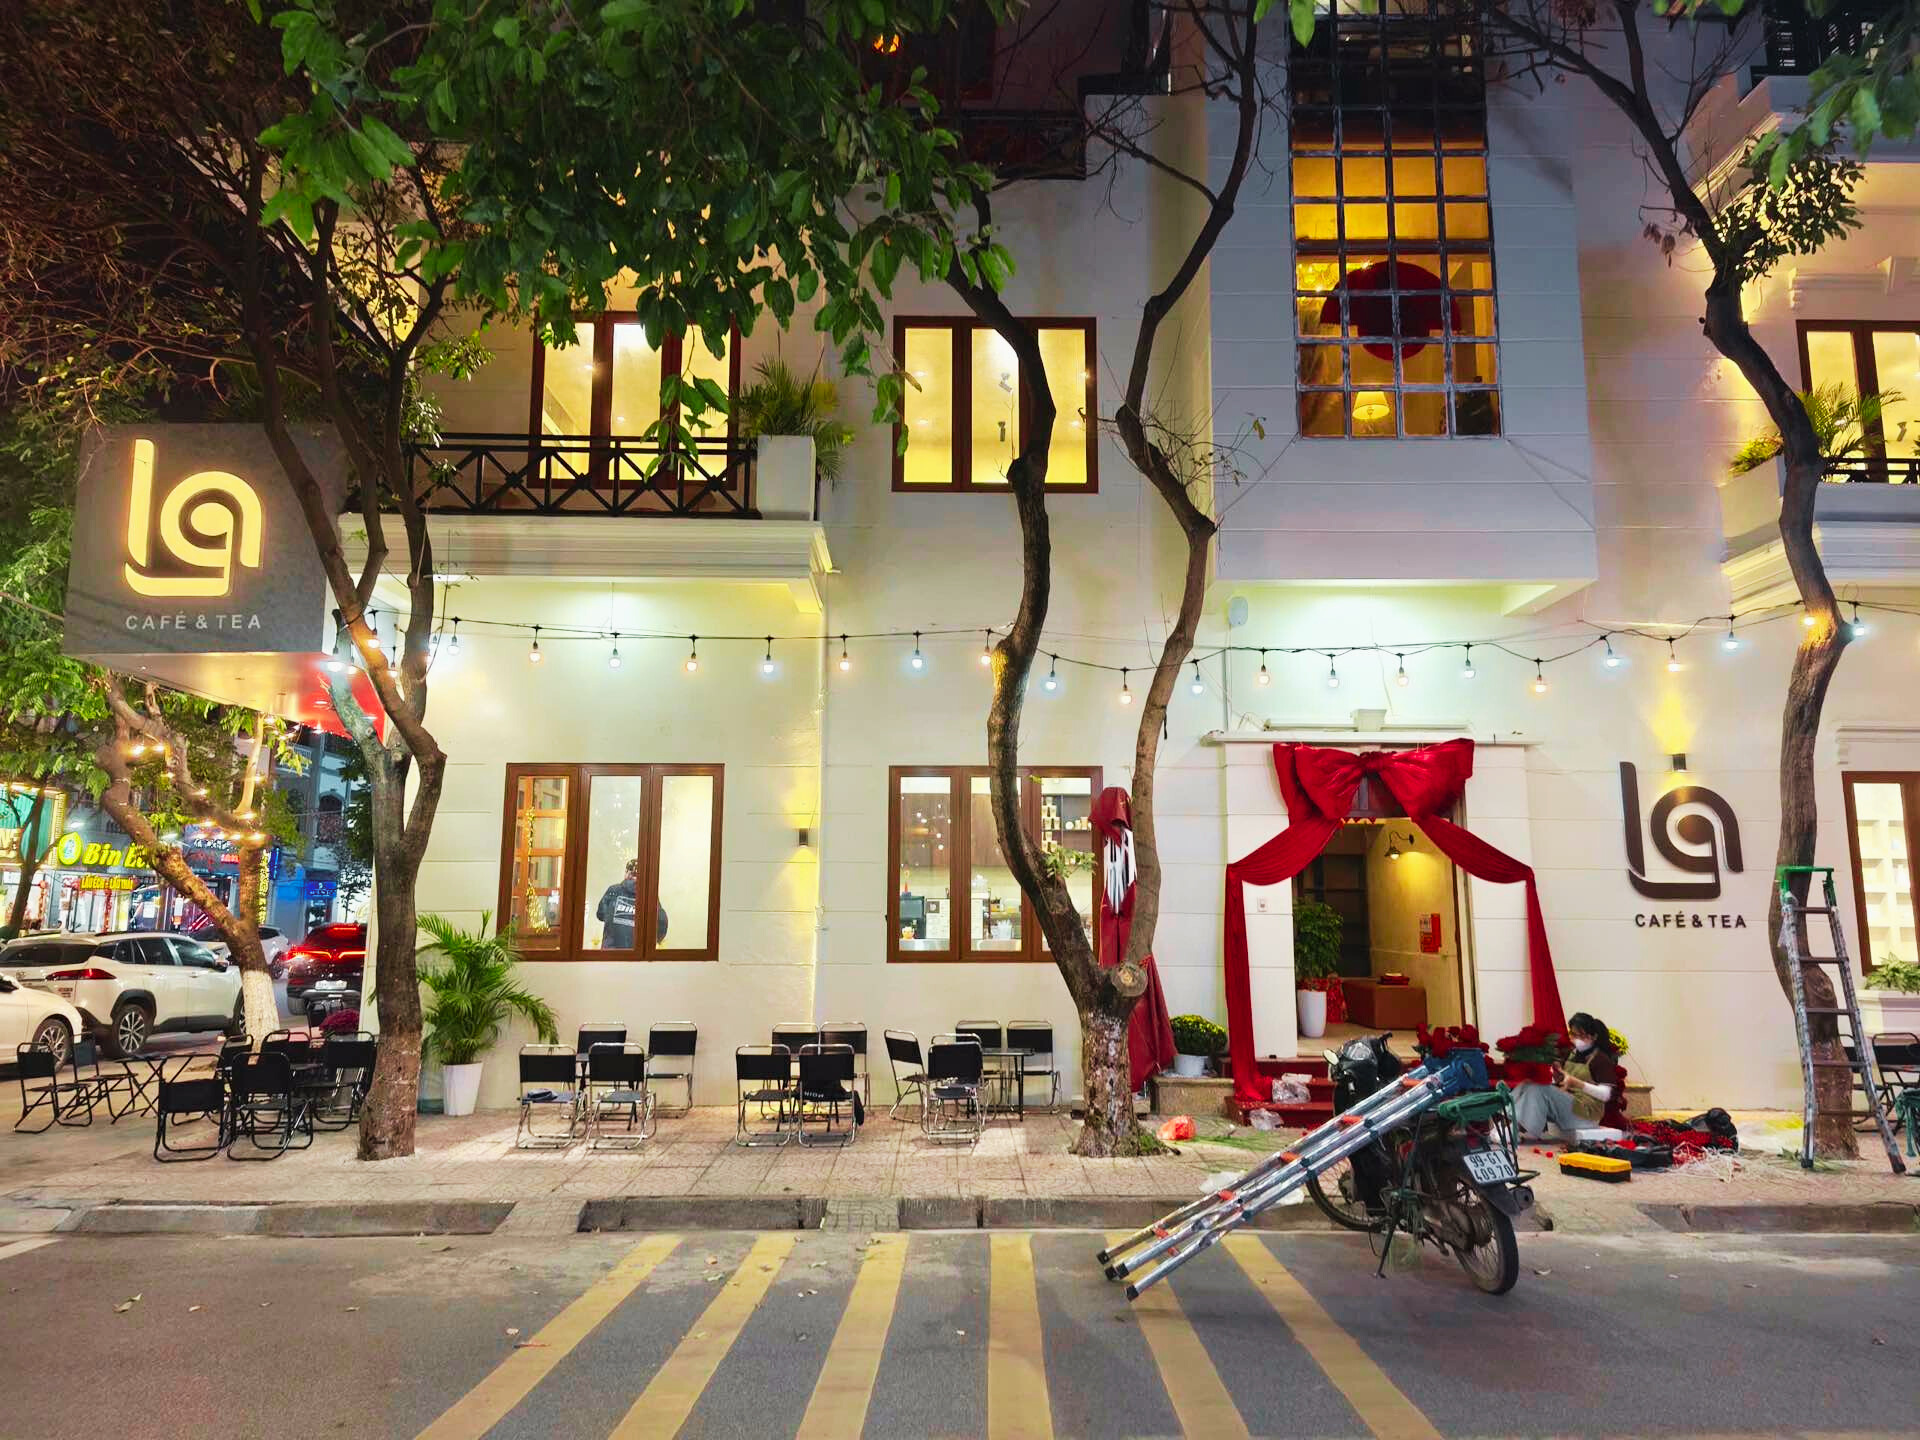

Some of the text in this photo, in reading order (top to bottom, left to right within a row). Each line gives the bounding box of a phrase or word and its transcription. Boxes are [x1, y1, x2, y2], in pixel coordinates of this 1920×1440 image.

[126, 611, 262, 630] CAFÉ & TEA
[82, 842, 122, 866] Bin
[1635, 911, 1747, 928] CAFÉ & TEA
